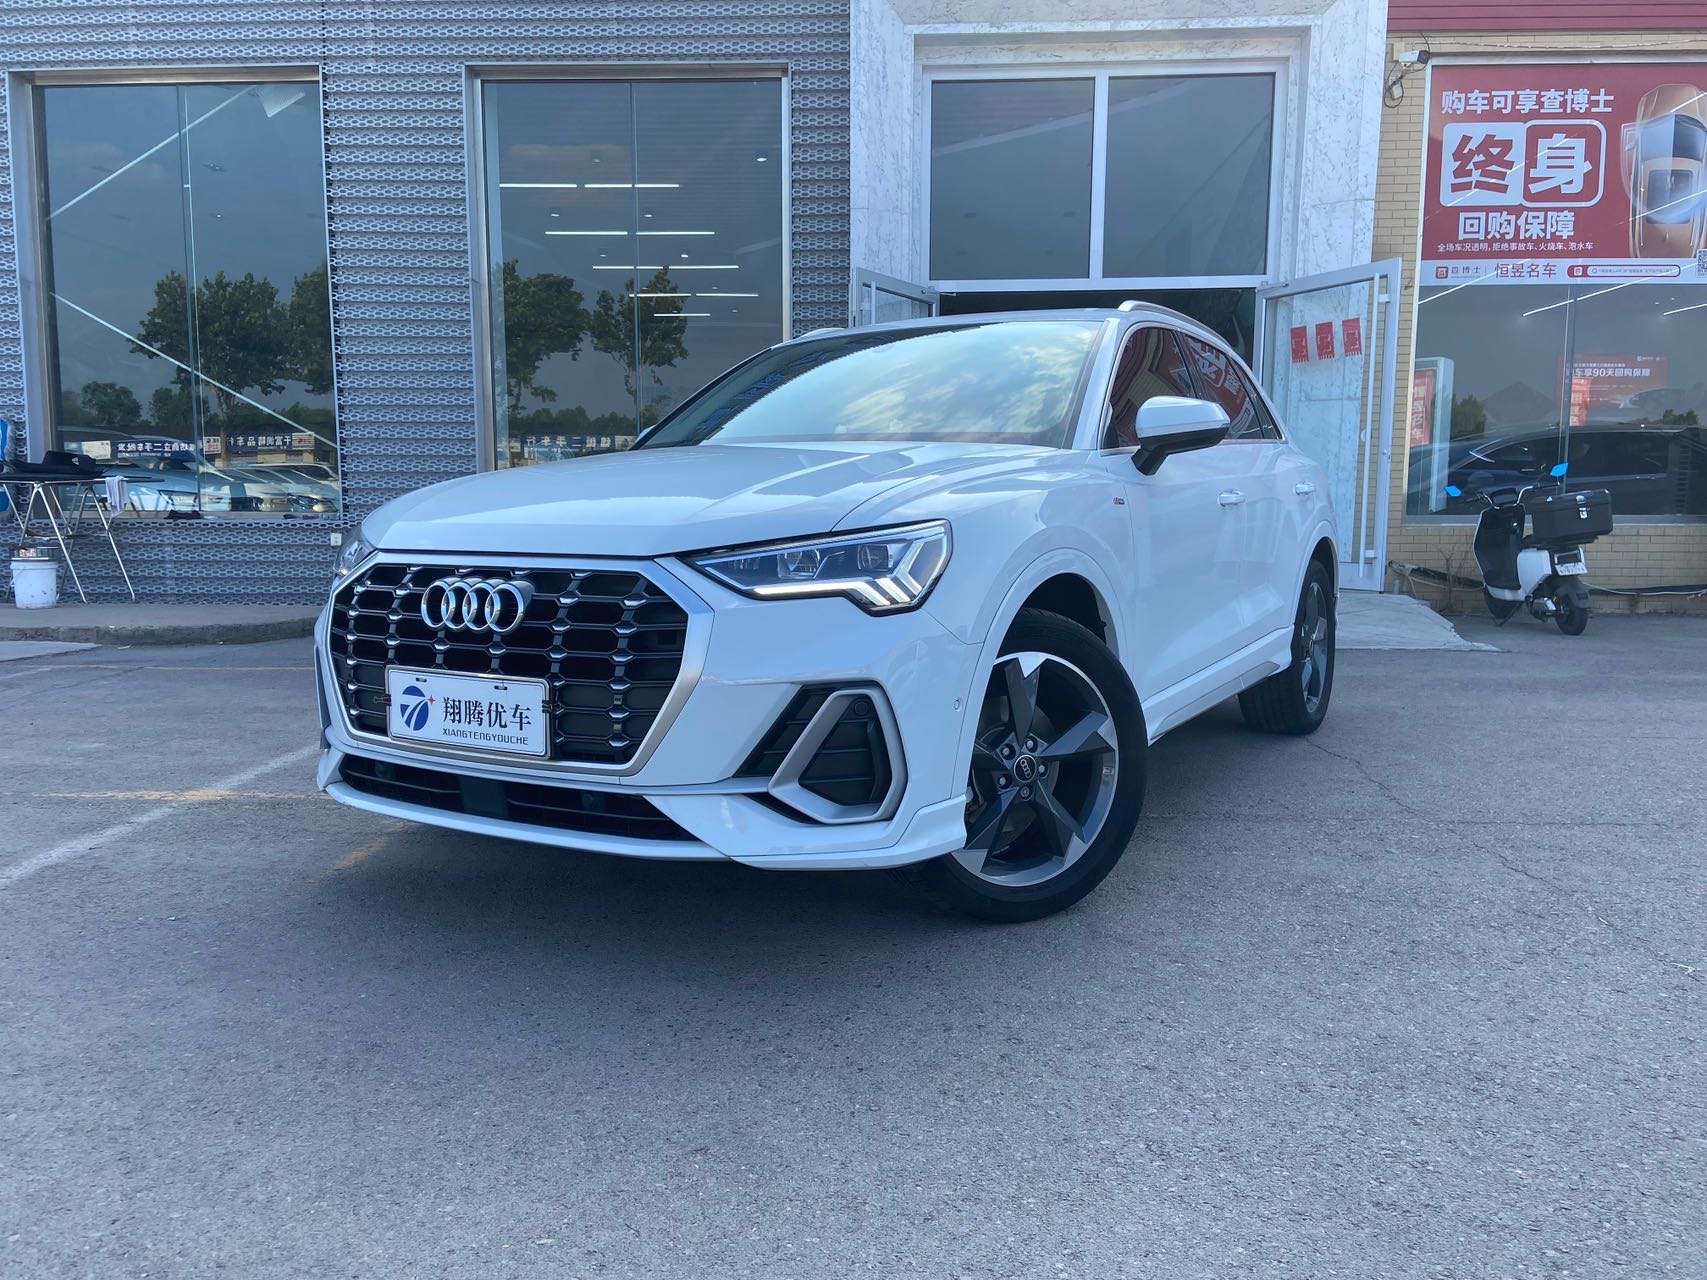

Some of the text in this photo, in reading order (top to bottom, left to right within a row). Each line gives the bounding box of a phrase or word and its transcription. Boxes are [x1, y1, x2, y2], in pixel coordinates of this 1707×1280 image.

[1442, 88, 1614, 114] 购车可享查博士
[1450, 133, 1593, 194] 终身
[1458, 210, 1575, 240] 回购保障
[1494, 263, 1557, 278] 恒昱名车
[443, 696, 532, 731] 翔腾优车
[442, 728, 529, 745] XIANGTENGYOUCHE
